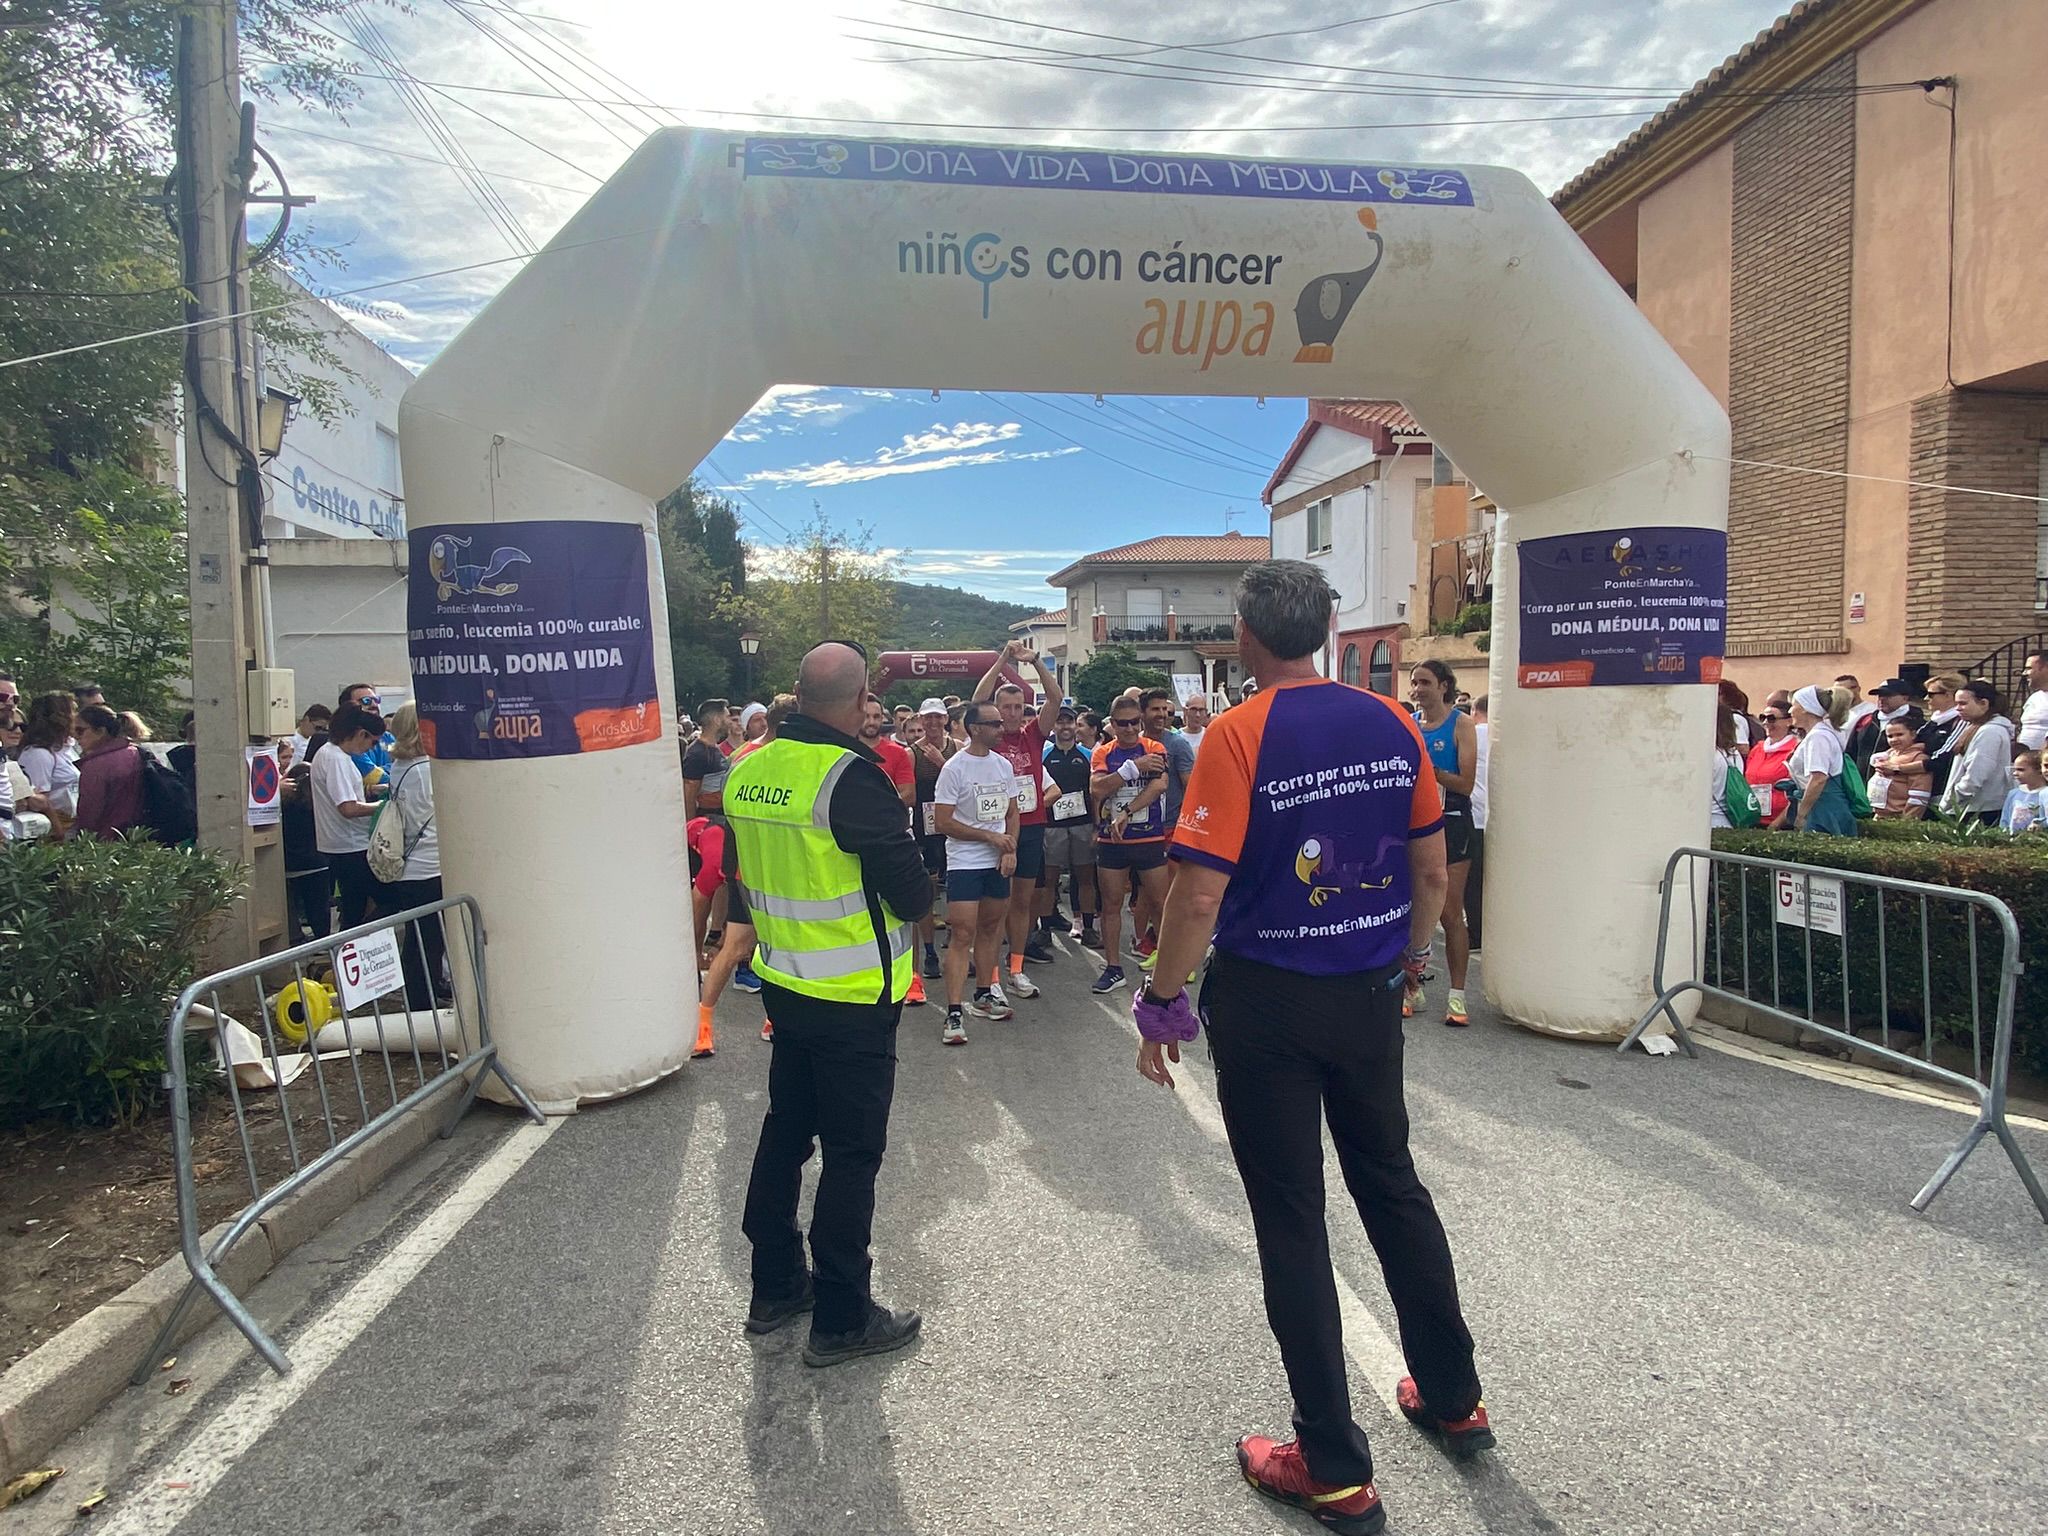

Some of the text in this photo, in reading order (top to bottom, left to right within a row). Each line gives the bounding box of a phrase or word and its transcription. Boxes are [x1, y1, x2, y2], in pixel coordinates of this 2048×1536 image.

[1046, 247, 1121, 281] con
[1138, 241, 1282, 285] cáncer
[1135, 297, 1275, 371] aupa
[293, 465, 361, 528] Centro
[1556, 602, 1576, 613] por
[1578, 601, 1593, 610] un
[1641, 596, 1687, 606] leucemia
[463, 622, 534, 638] leucemia
[537, 618, 584, 636] 100%
[1551, 620, 1593, 636] DONA
[1597, 615, 1665, 633] MÉDULA,
[1668, 617, 1701, 631] DONA
[505, 651, 569, 675] DONA
[573, 647, 623, 669] VIDA
[1657, 656, 1685, 675] aupa
[1525, 670, 1561, 683] PDA
[494, 714, 542, 743] aupa
[1317, 766, 1339, 786] por
[1343, 763, 1366, 777] un
[734, 785, 793, 806] ALCALDE
[1056, 800, 1074, 811] 956
[1271, 787, 1332, 812] leucemia
[1332, 779, 1370, 796] 100%
